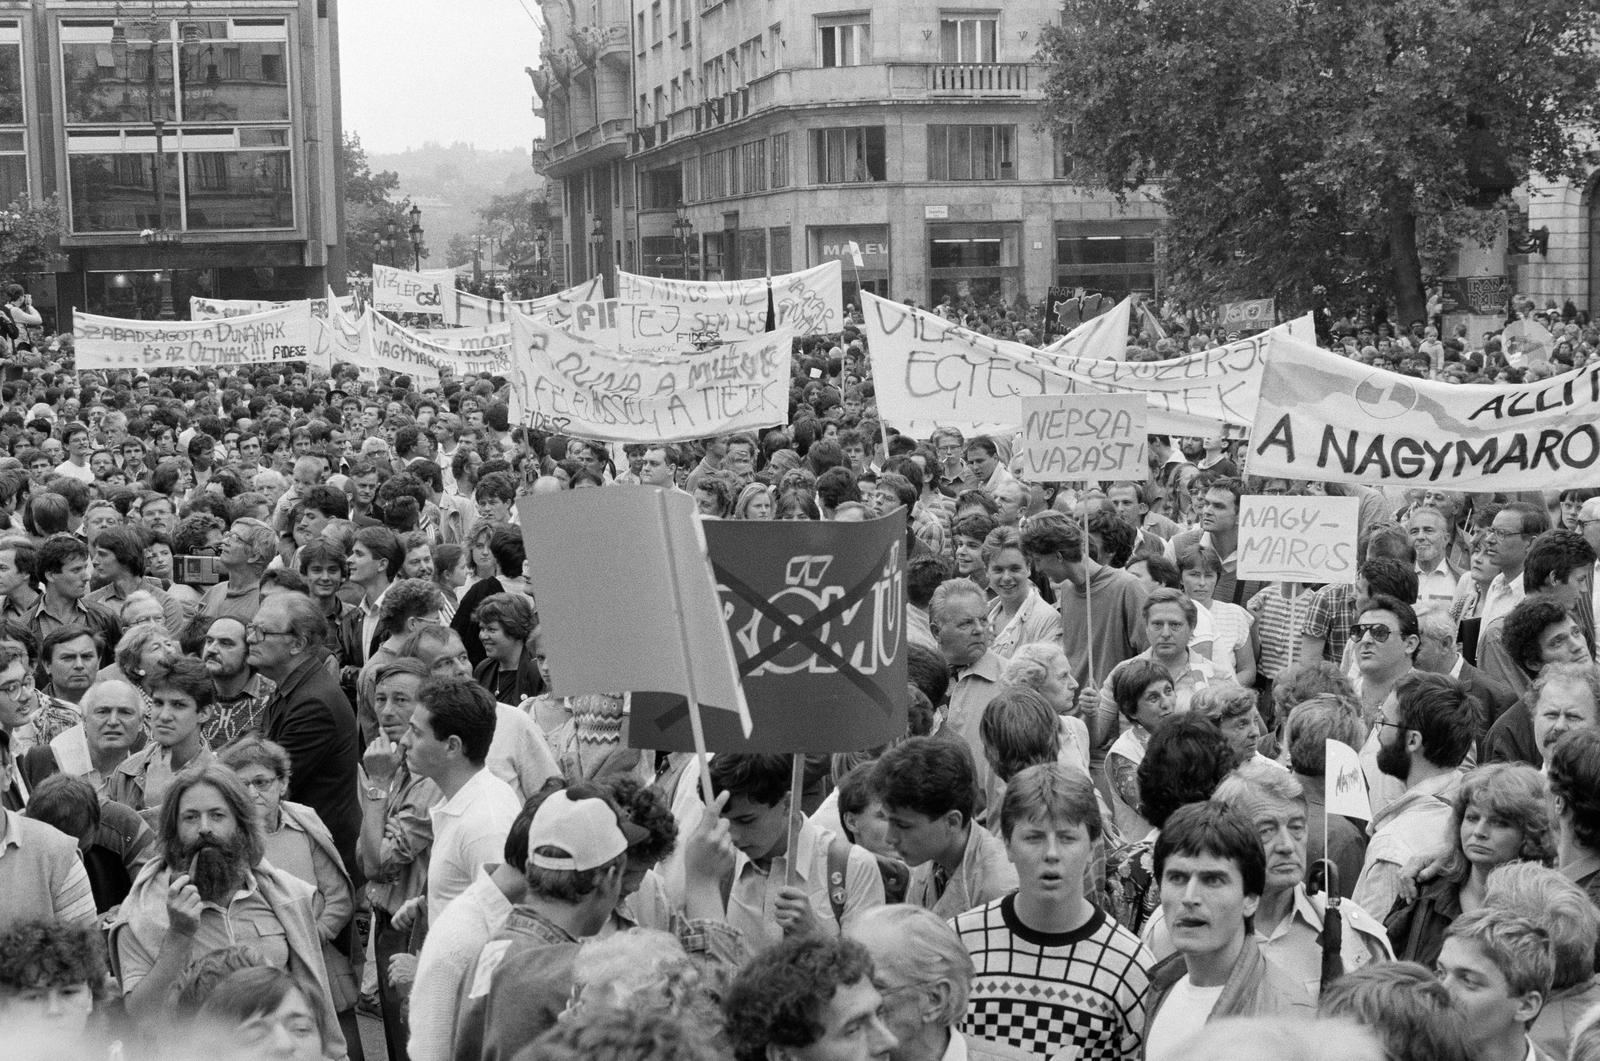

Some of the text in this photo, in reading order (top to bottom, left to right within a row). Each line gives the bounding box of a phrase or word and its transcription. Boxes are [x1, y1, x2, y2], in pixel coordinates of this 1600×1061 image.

[203, 330, 214, 341] A
[621, 302, 681, 339] TEJ
[166, 347, 185, 361] AZ
[667, 394, 695, 426] A
[1257, 413, 1296, 464] A
[1241, 536, 1349, 572] MAROS
